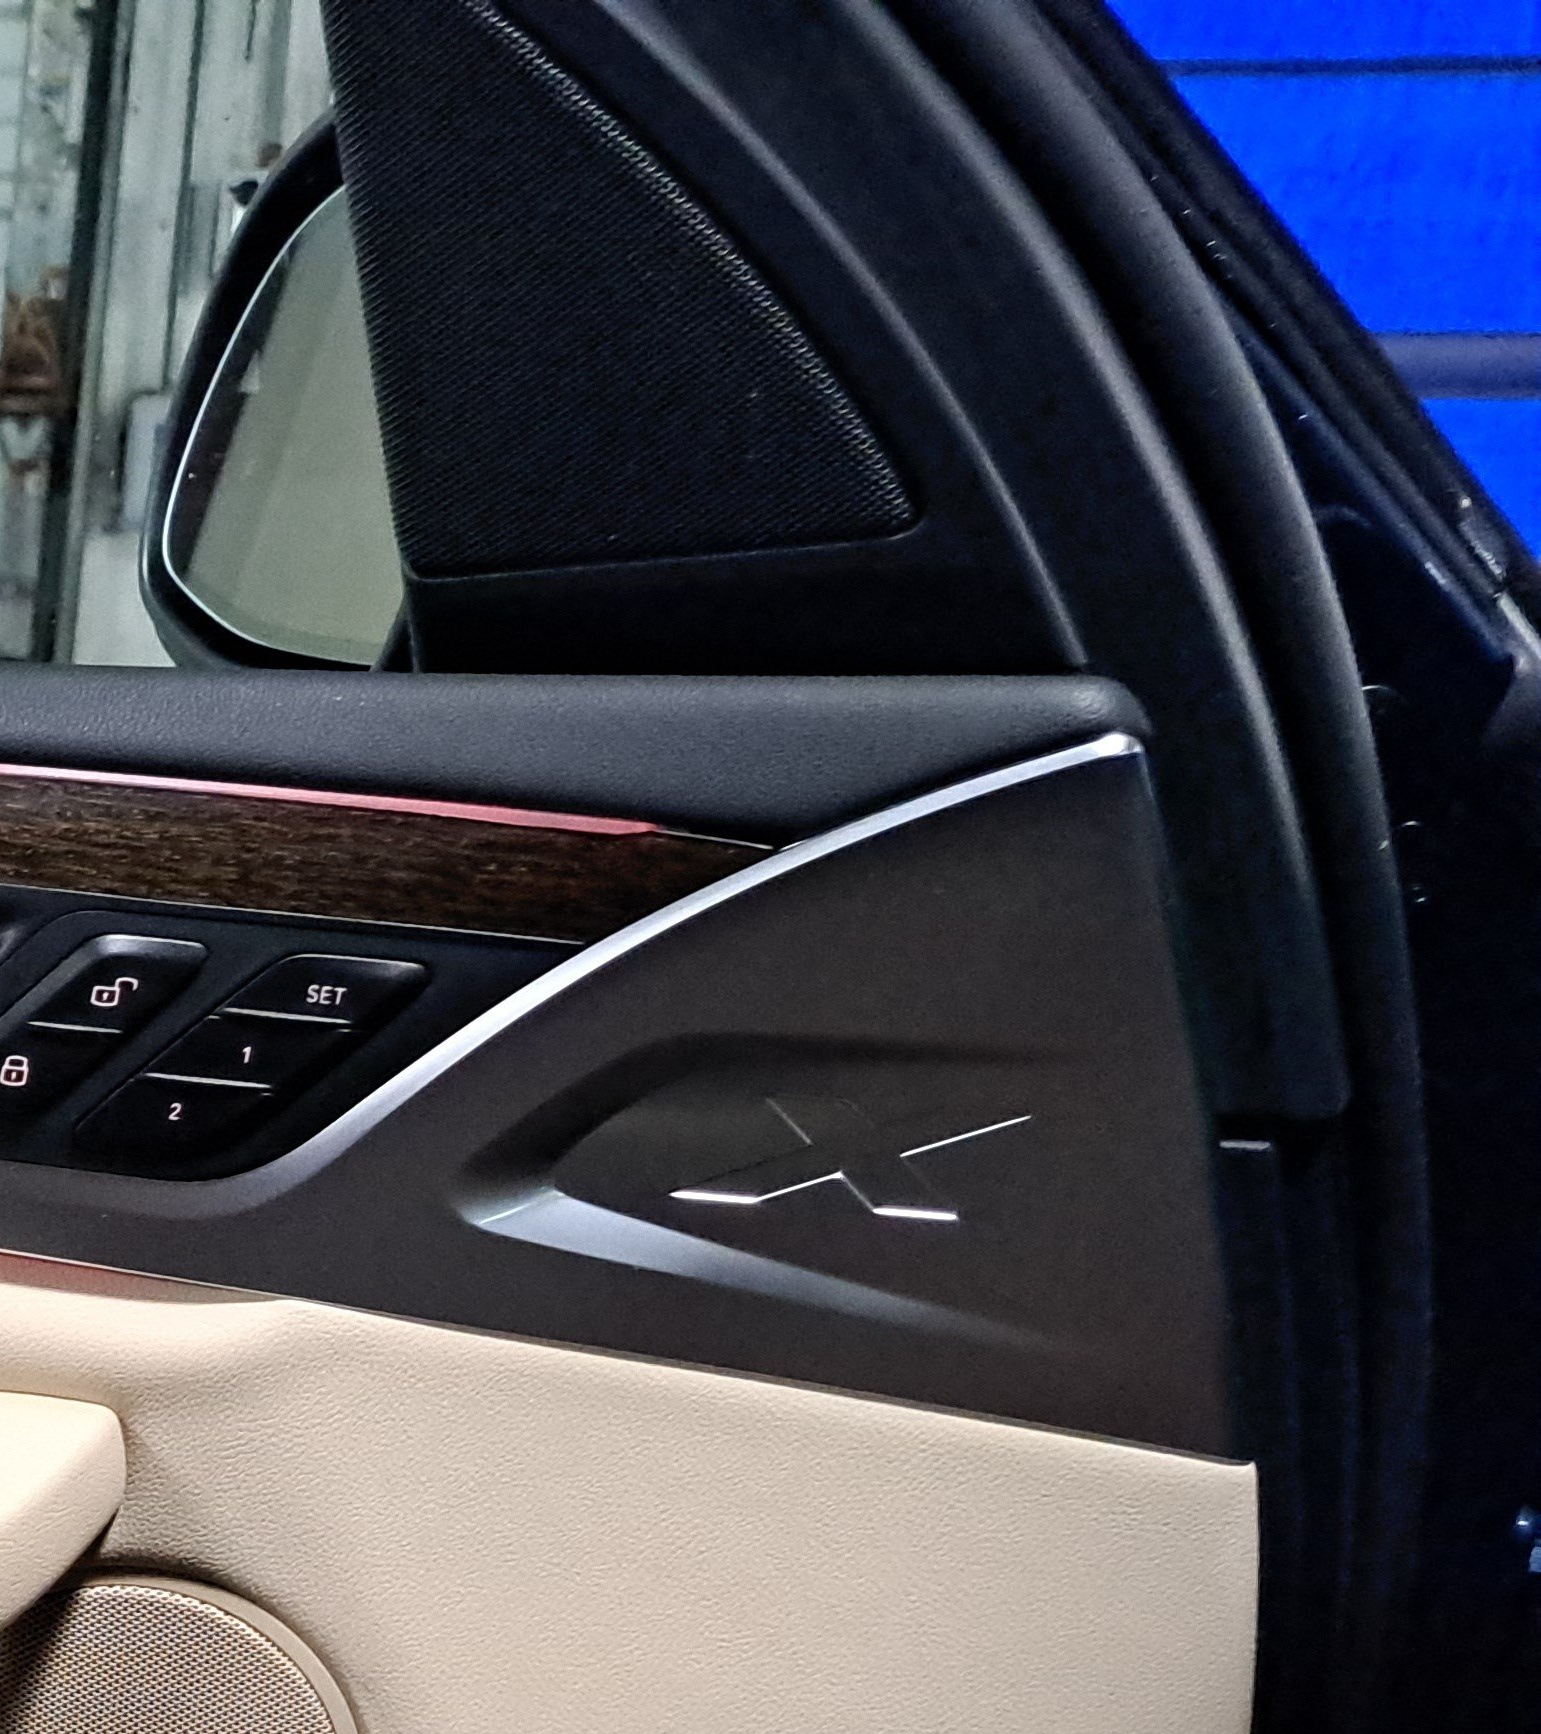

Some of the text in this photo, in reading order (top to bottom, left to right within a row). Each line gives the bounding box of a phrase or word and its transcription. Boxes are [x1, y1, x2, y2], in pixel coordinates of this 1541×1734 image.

[305, 984, 348, 1006] SET
[242, 1046, 252, 1064] 1
[167, 1102, 182, 1121] 2
